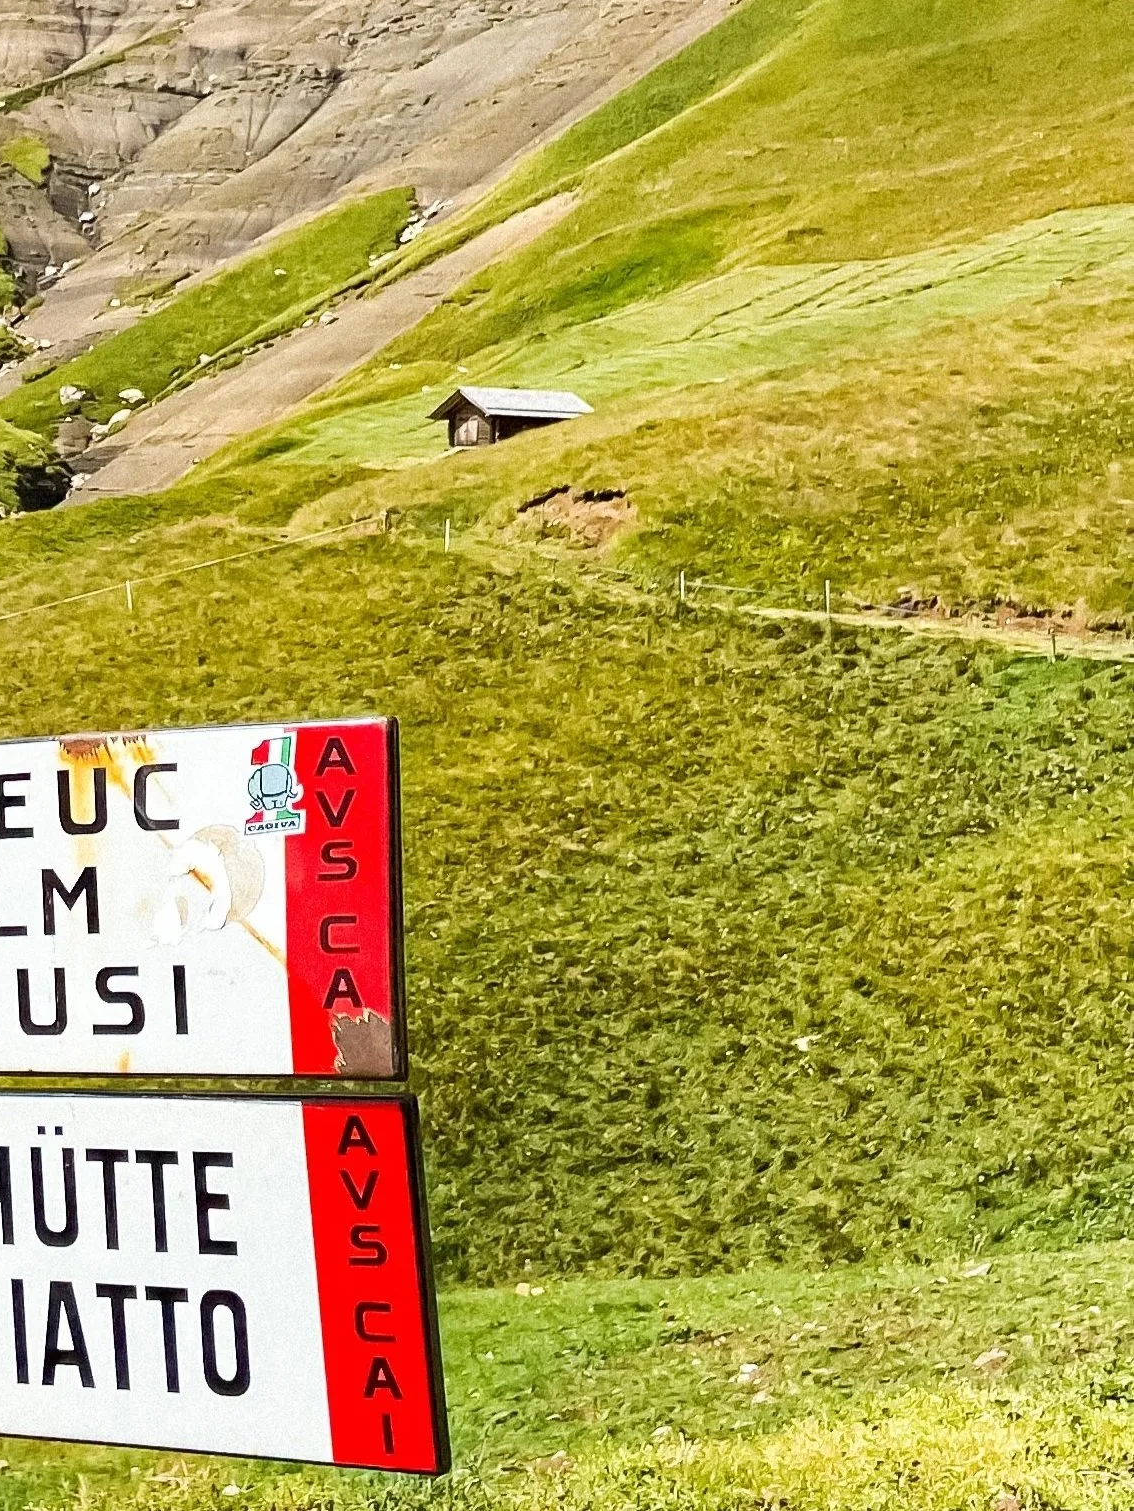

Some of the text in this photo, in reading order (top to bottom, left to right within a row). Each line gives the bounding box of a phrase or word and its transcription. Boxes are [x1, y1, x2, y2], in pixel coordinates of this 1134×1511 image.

[315, 736, 360, 882] AVS
[338, 1115, 403, 1455] AVS CAI
